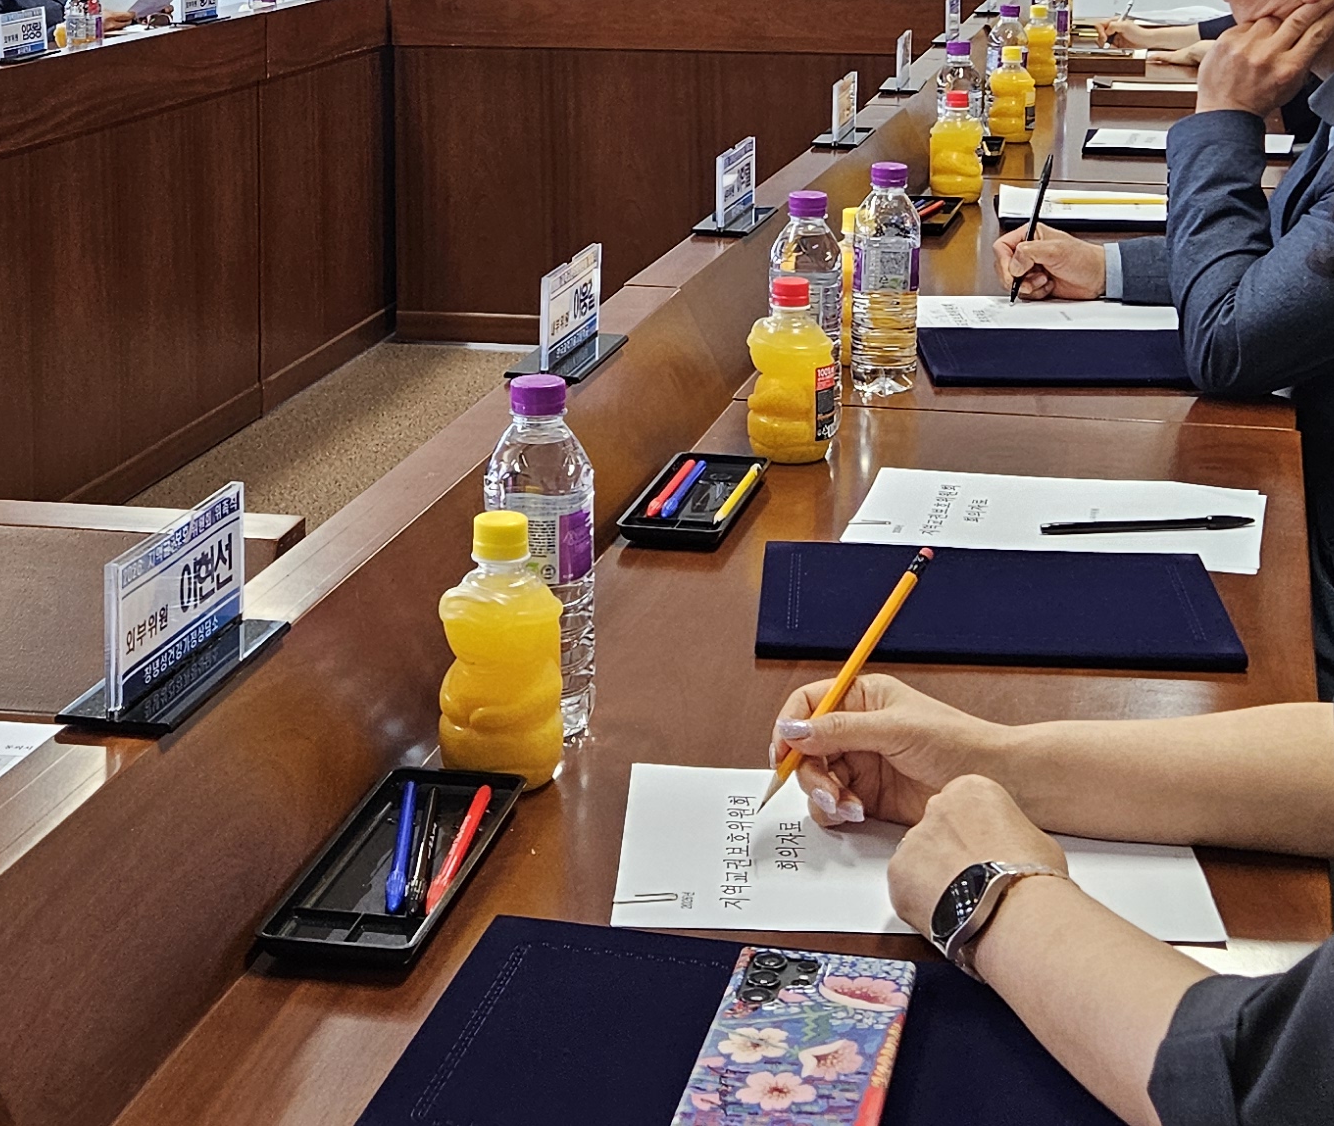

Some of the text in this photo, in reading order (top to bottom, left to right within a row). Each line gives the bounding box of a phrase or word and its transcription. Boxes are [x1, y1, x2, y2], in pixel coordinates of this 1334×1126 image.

[125, 604, 169, 656] 외부위원
[719, 795, 757, 910] 지역교권보호위원회
[775, 821, 806, 871] 회의자료
